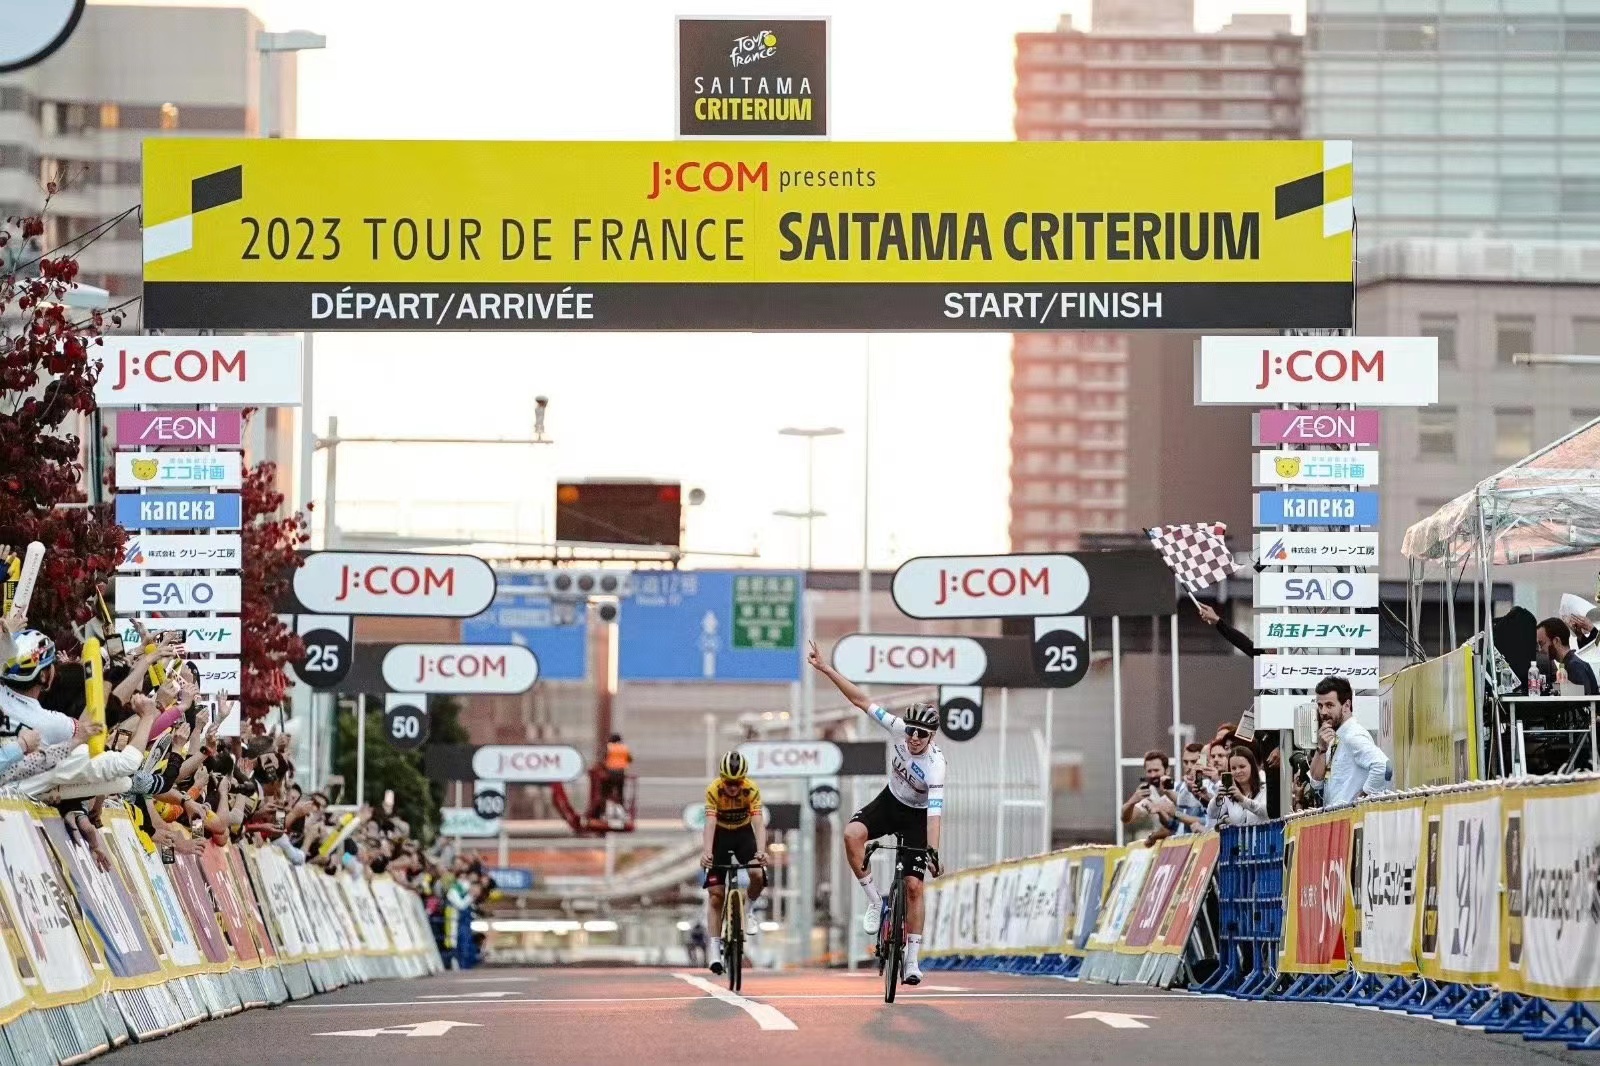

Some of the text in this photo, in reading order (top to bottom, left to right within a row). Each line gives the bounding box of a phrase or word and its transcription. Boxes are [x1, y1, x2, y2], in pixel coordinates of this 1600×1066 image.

[695, 77, 811, 94] SAITAMA
[695, 98, 811, 120] CRITERIUM
[647, 161, 875, 200] J:COM presents
[242, 212, 1260, 262] 2023 TOUR DE FRANCE SAITAMA CRITERIUM
[311, 286, 594, 325] DÉPART/ARRIVÉE
[944, 292, 1163, 324] START/FINISH
[112, 350, 246, 390] J:COM
[1256, 350, 1384, 389] J:COM
[161, 465, 225, 480] エコ計画
[1303, 464, 1364, 478] エコ計画
[148, 549, 236, 558] 株式会社 クリーン工房
[1320, 547, 1375, 556] クリーン工房
[336, 565, 454, 601] J:COM
[935, 567, 1050, 605] J:COM
[124, 628, 232, 643] 埼ペット
[1267, 622, 1372, 638] 埼玉トヨペット
[305, 644, 339, 672] 25
[416, 655, 506, 683] J:COM
[866, 646, 956, 673] J:COM
[1045, 646, 1078, 672] 25
[1281, 667, 1377, 676] ヒト・コミュニケーションズ
[391, 715, 420, 738] 50
[947, 709, 975, 731] 50
[475, 795, 504, 814] 100
